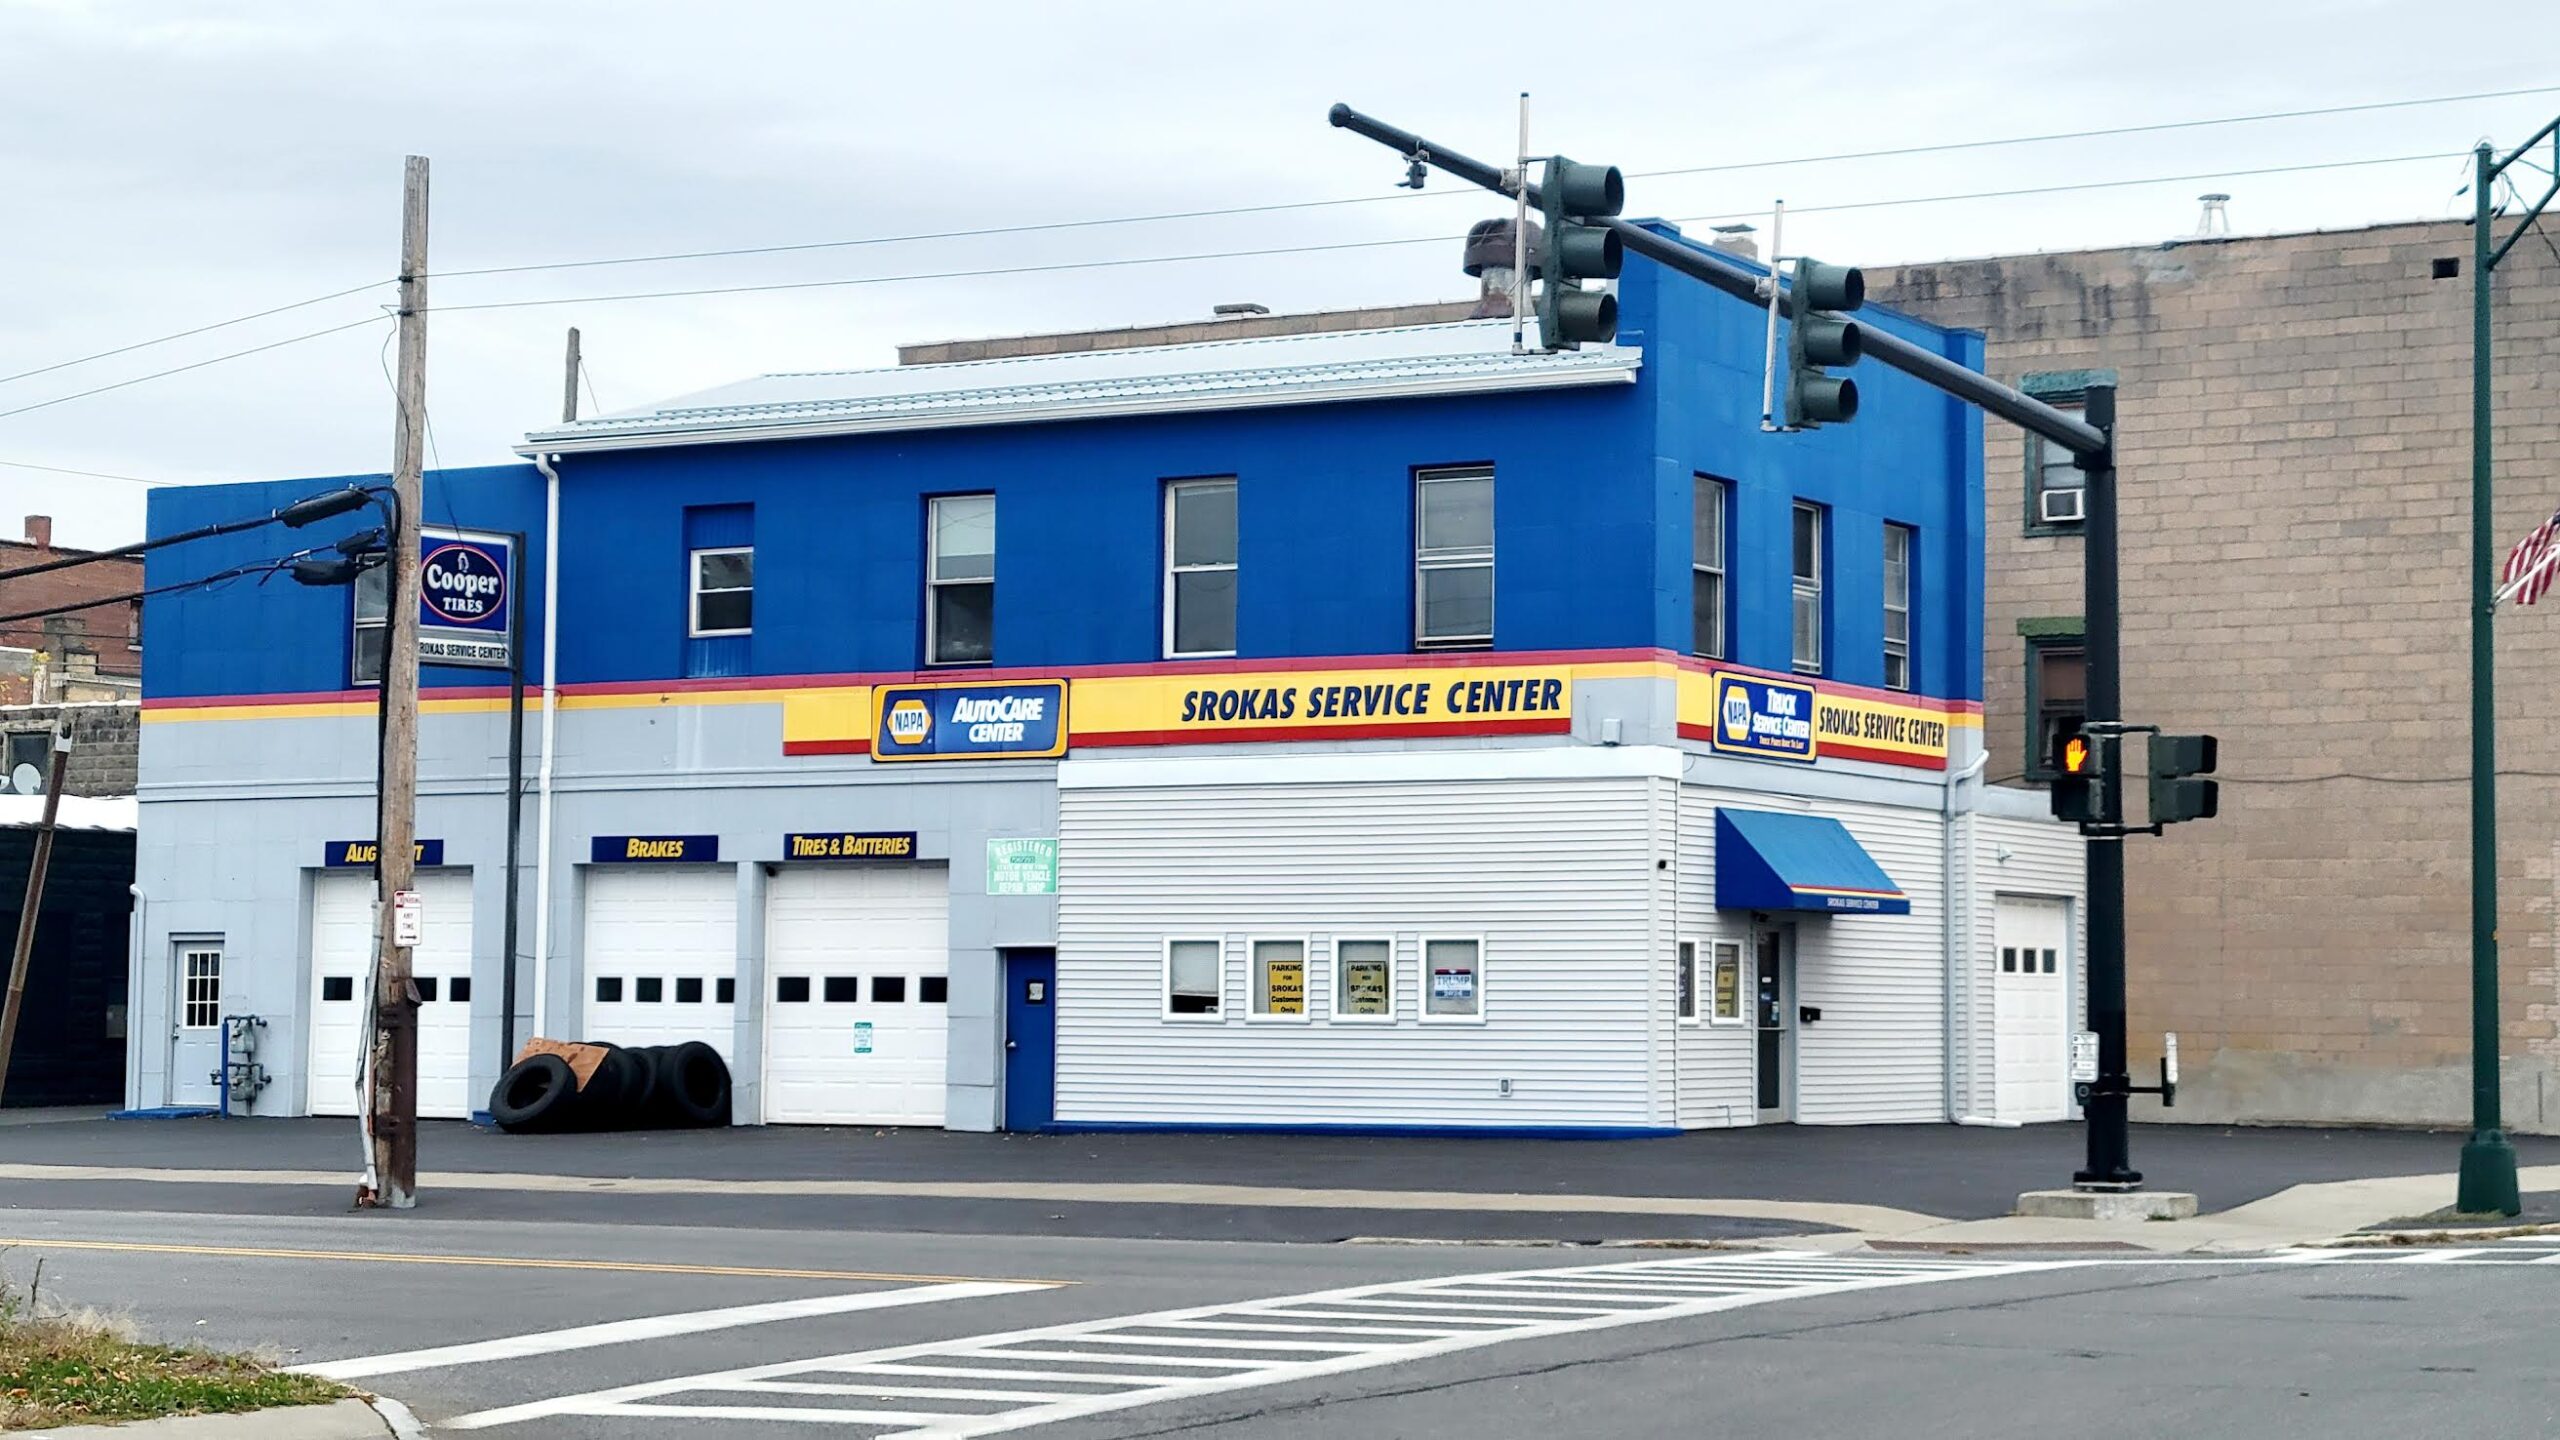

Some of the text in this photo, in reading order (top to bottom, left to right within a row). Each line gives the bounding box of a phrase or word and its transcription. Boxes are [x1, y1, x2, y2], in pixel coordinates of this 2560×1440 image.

[426, 563, 499, 598] Cooper
[442, 597, 484, 614] TIRES
[446, 644, 477, 658] SERVICE
[478, 647, 506, 660] CENTER
[1181, 678, 1563, 722] SROKAS SERVICE CENTER
[1766, 687, 1798, 717] TRUCK
[894, 711, 924, 733] NAPA
[1727, 700, 1748, 728] NAPA
[968, 722, 1025, 743] CENTER
[1752, 711, 1811, 739] SERVICE CENTER
[1818, 705, 1945, 749] SROKAS SERVICE CENTER
[625, 837, 685, 858] BRAKES
[792, 835, 911, 857] TIRES & BATTERIES
[994, 839, 1053, 857] REGISTERED
[1271, 964, 1303, 972] PARKING
[1280, 1006, 1296, 1014] Only
[1359, 1006, 1375, 1014] Only
